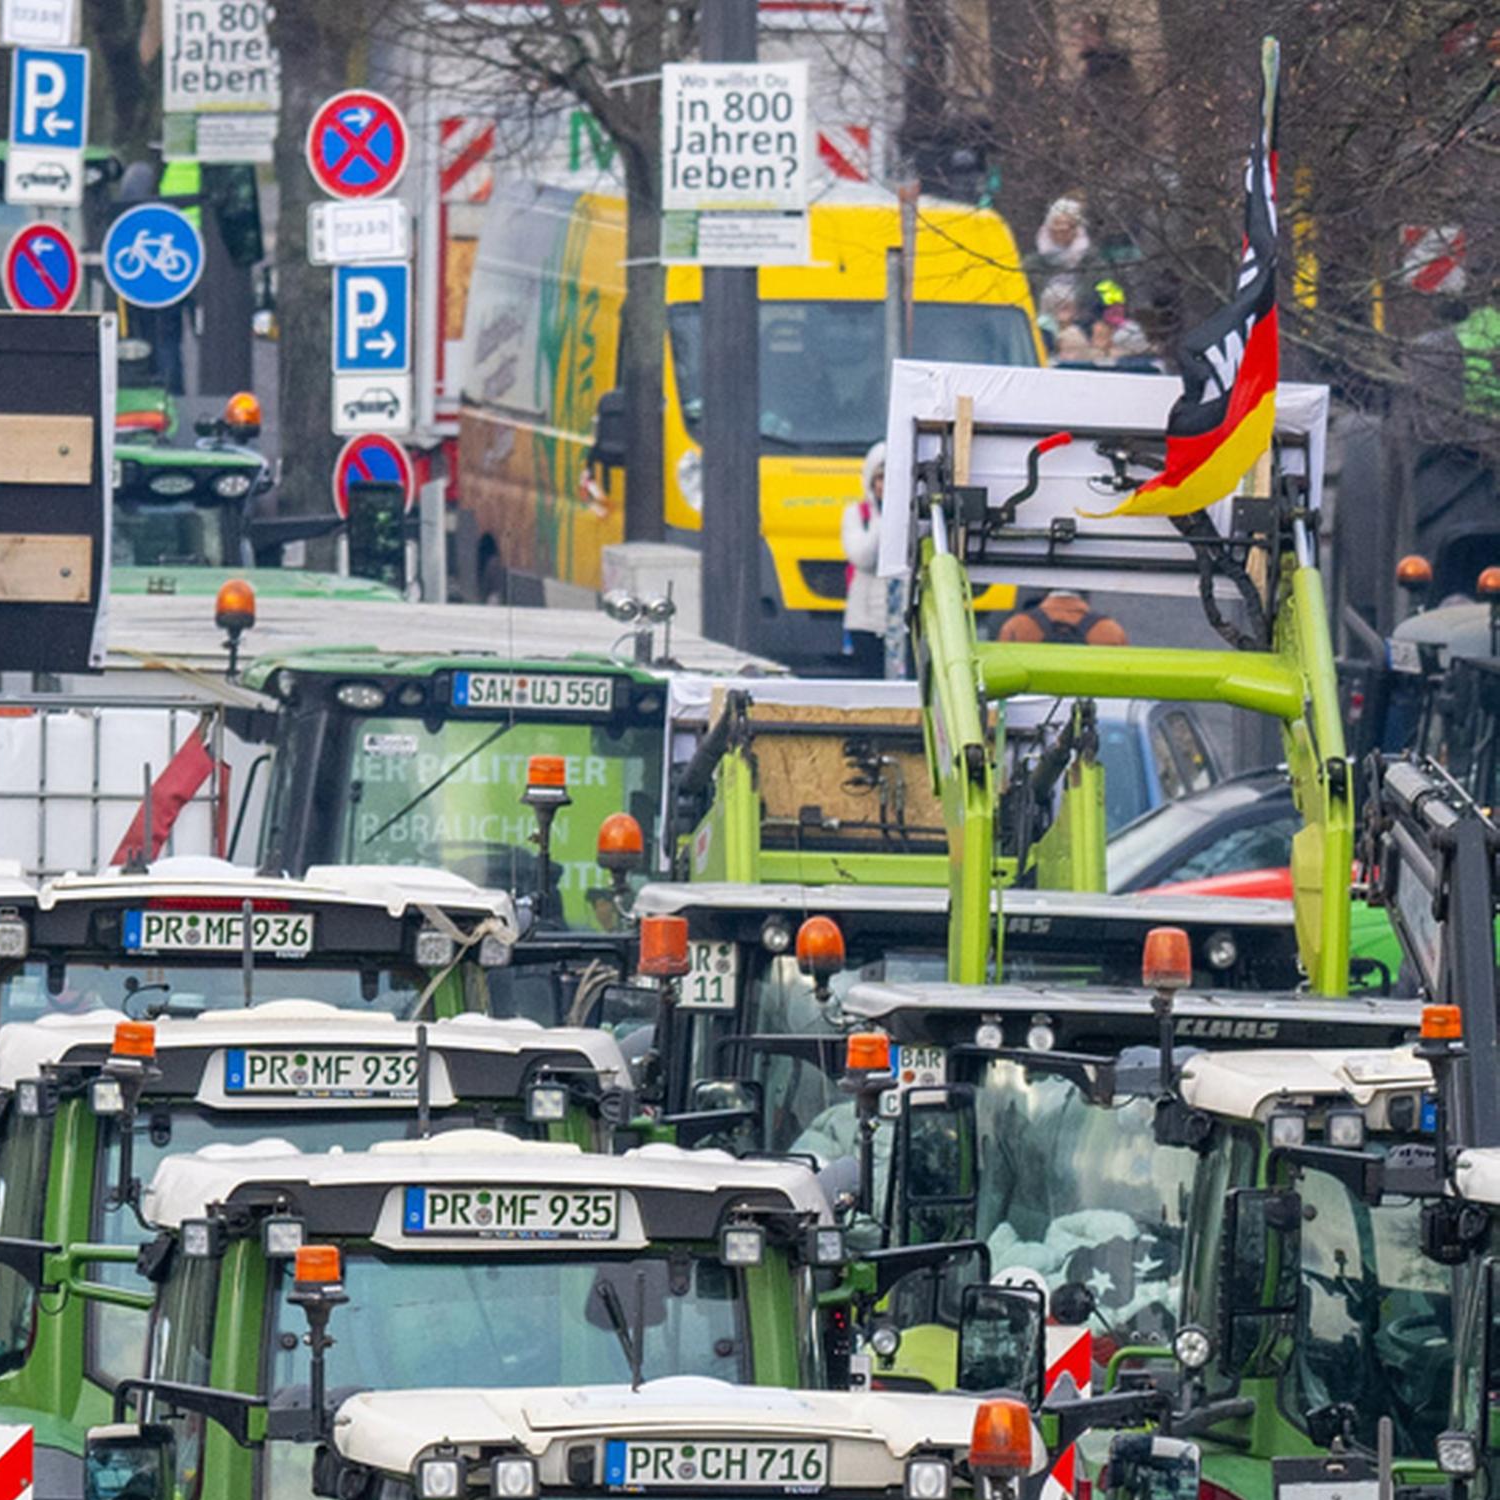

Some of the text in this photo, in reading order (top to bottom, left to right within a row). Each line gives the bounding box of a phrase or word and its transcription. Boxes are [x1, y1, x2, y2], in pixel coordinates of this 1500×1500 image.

[176, 3, 206, 32] in
[23, 60, 66, 136] P
[677, 90, 793, 123] in 800
[670, 123, 797, 155] Jahren
[670, 156, 798, 189] leben?
[346, 276, 388, 359] P
[531, 680, 561, 705] UJ
[416, 753, 607, 786] POLITER
[144, 915, 183, 944] PR
[204, 916, 244, 945] MF
[252, 917, 308, 947] 936
[1174, 1018, 1280, 1039] CLAAS
[248, 1055, 289, 1085] PR
[311, 1056, 355, 1086] MF
[362, 1056, 418, 1086] 939
[901, 1047, 942, 1069] BAR
[428, 1193, 471, 1225] PR
[496, 1194, 541, 1226] MF
[549, 1194, 613, 1227] 935
[629, 1447, 674, 1480] PR
[700, 1447, 748, 1480] CH
[757, 1448, 822, 1481] 716
